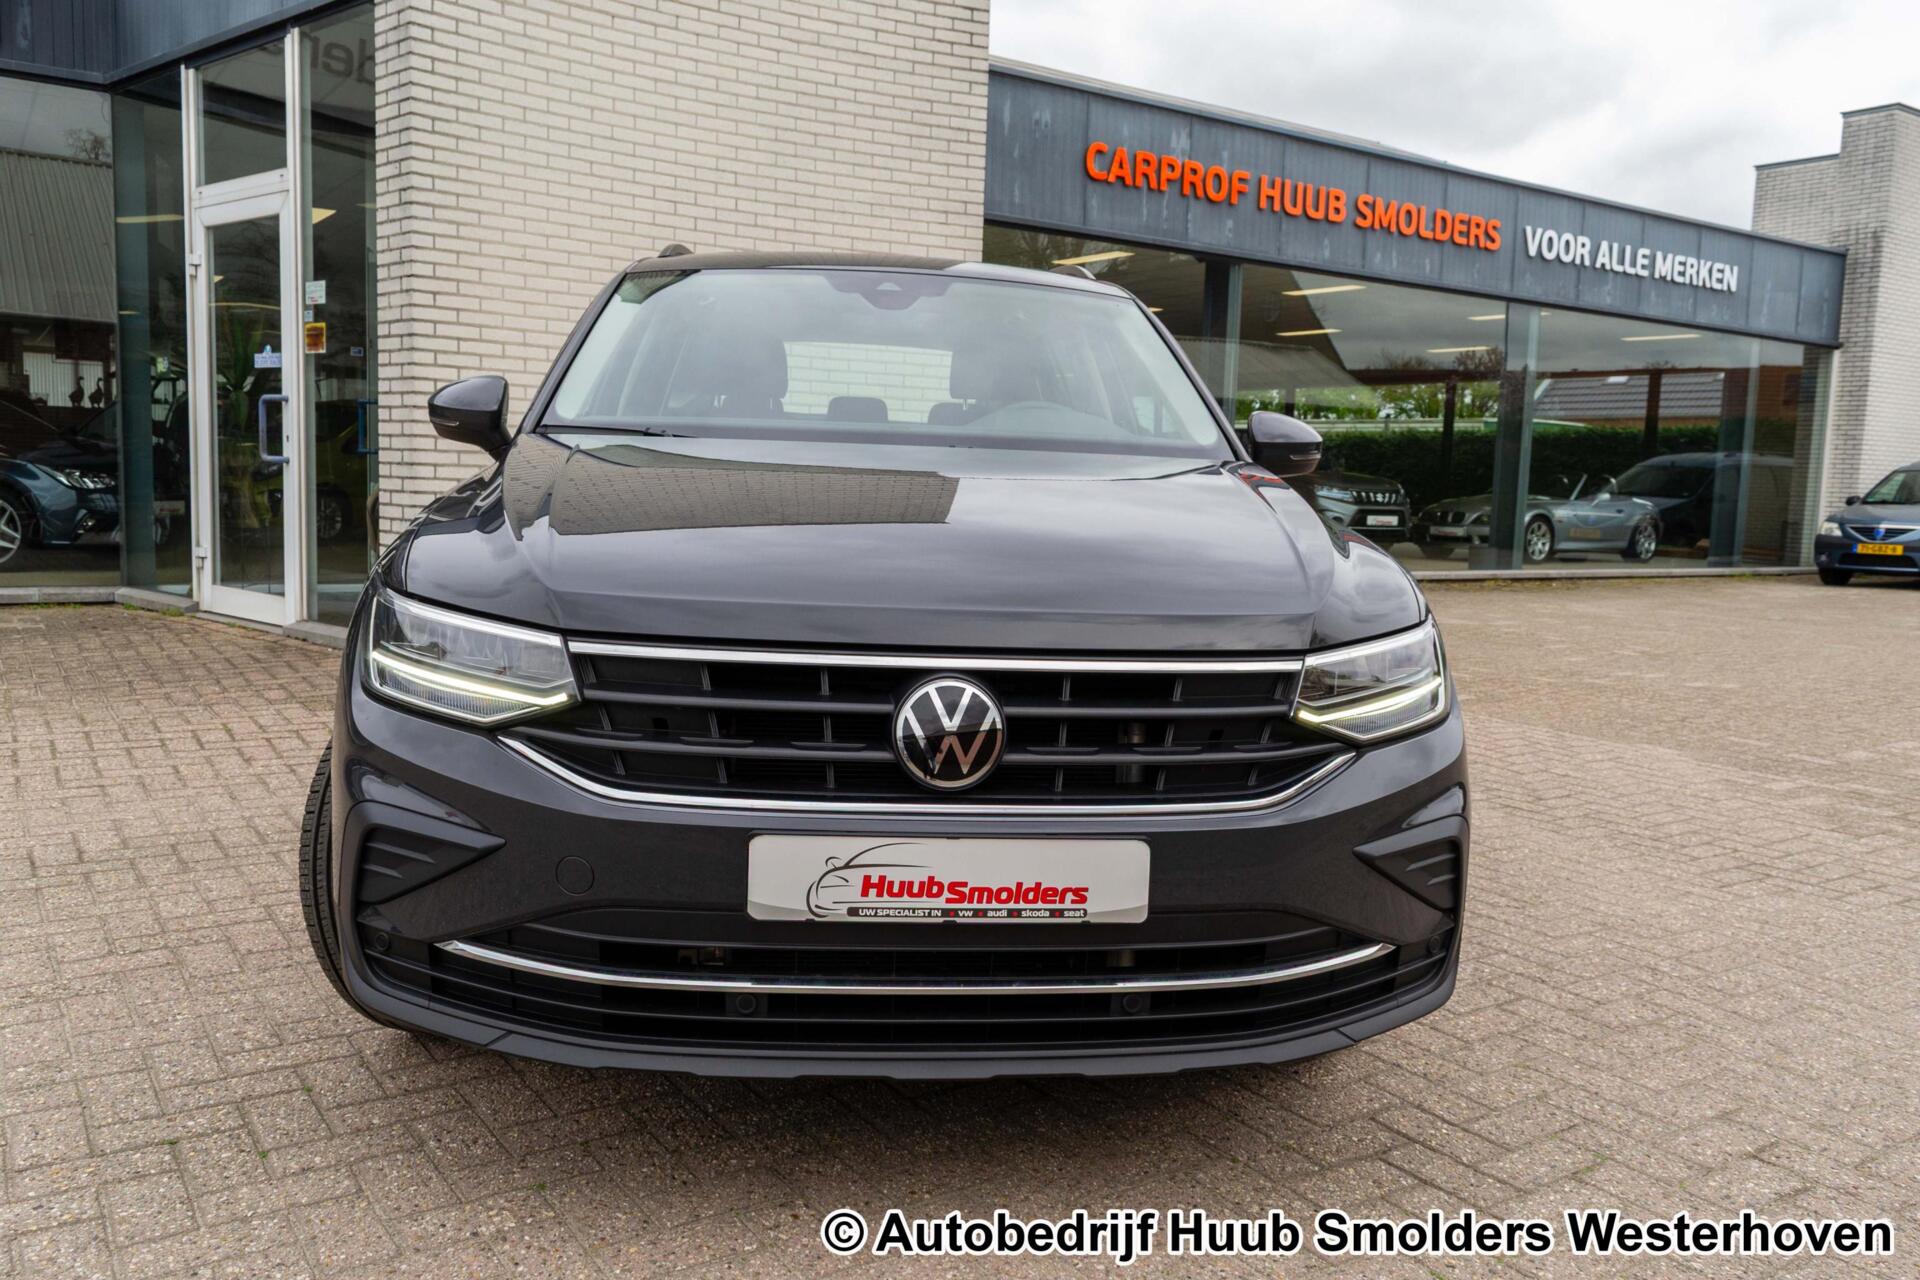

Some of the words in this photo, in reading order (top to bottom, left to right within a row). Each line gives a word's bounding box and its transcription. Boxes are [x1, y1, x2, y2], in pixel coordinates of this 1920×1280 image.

[1086, 141, 1250, 206] CARPROF
[1259, 174, 1346, 223] HUUB
[1355, 194, 1501, 250] SMOLDERS
[1525, 225, 1591, 267] VOOR
[1595, 239, 1651, 277] ALLE
[1654, 250, 1739, 292] MERKEN
[858, 908, 877, 917] UW
[876, 908, 930, 917] SPECIALIST
[931, 909, 942, 917] IN
[987, 909, 1008, 917] audi
[1021, 909, 1050, 917] skoda
[1063, 909, 1085, 917] seat
